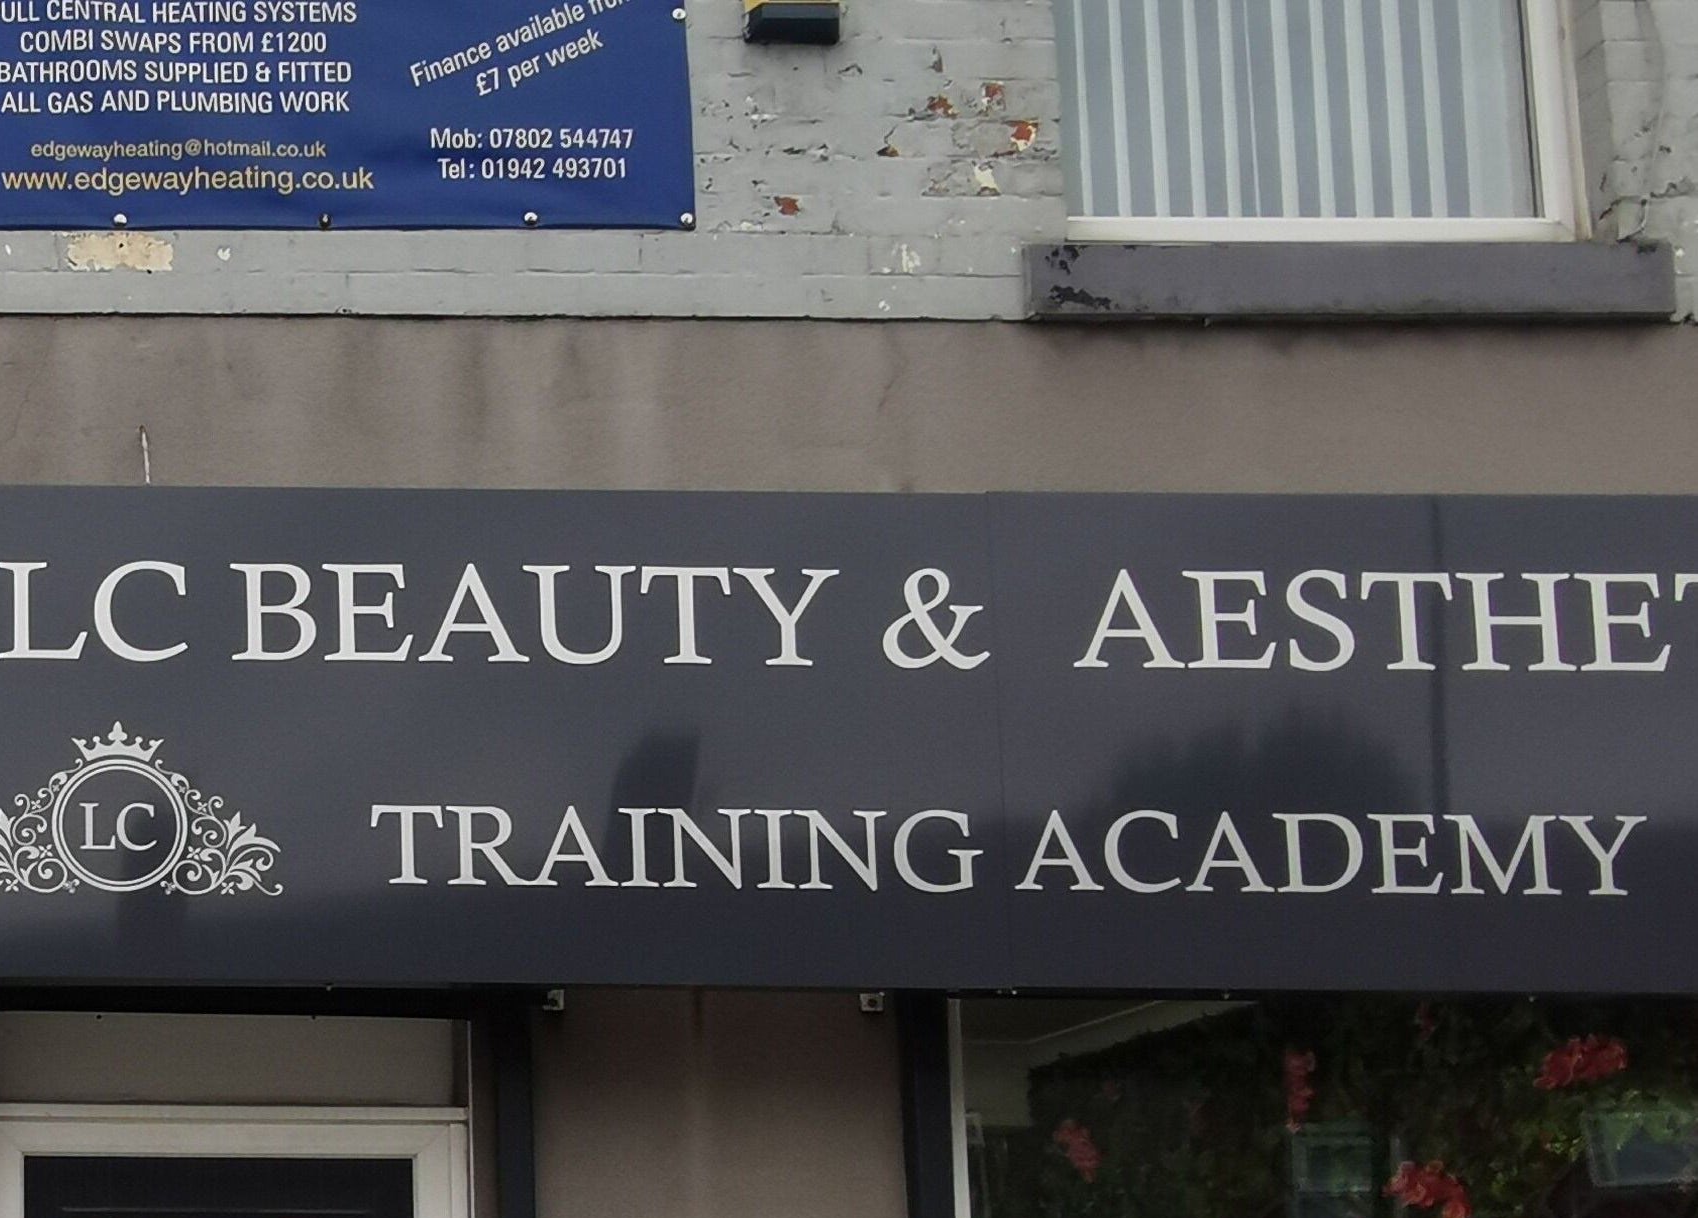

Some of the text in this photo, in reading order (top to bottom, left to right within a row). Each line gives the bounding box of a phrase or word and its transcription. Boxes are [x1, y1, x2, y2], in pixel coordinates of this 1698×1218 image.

[47, 0, 145, 23] CENTRAL
[153, 1, 246, 23] HEATING
[254, 1, 356, 22] SYSTEMS
[21, 29, 326, 53] COMBI SWAPS FROM £1200
[410, 41, 492, 87] Finance
[496, 2, 585, 52] available
[145, 61, 247, 83] SUPPLIED
[256, 62, 271, 82] &
[279, 62, 351, 82] FITTED
[475, 27, 605, 97] £7 per week
[1, 90, 349, 113] ALL GAS AND PLUMBING WORK
[31, 139, 326, 161] edgewayheating@hotmail.co.uk
[431, 128, 632, 148] Mob: 07802 544747
[2, 166, 374, 195] www.edgewayheating.co.uk
[438, 158, 625, 179] Tel: 01942 493701
[230, 563, 839, 665] BEAUTY
[883, 568, 990, 669] &
[1074, 569, 1698, 671] AESTHE
[79, 803, 156, 850] LC
[371, 805, 1647, 895] TRAINING ACADEMY
